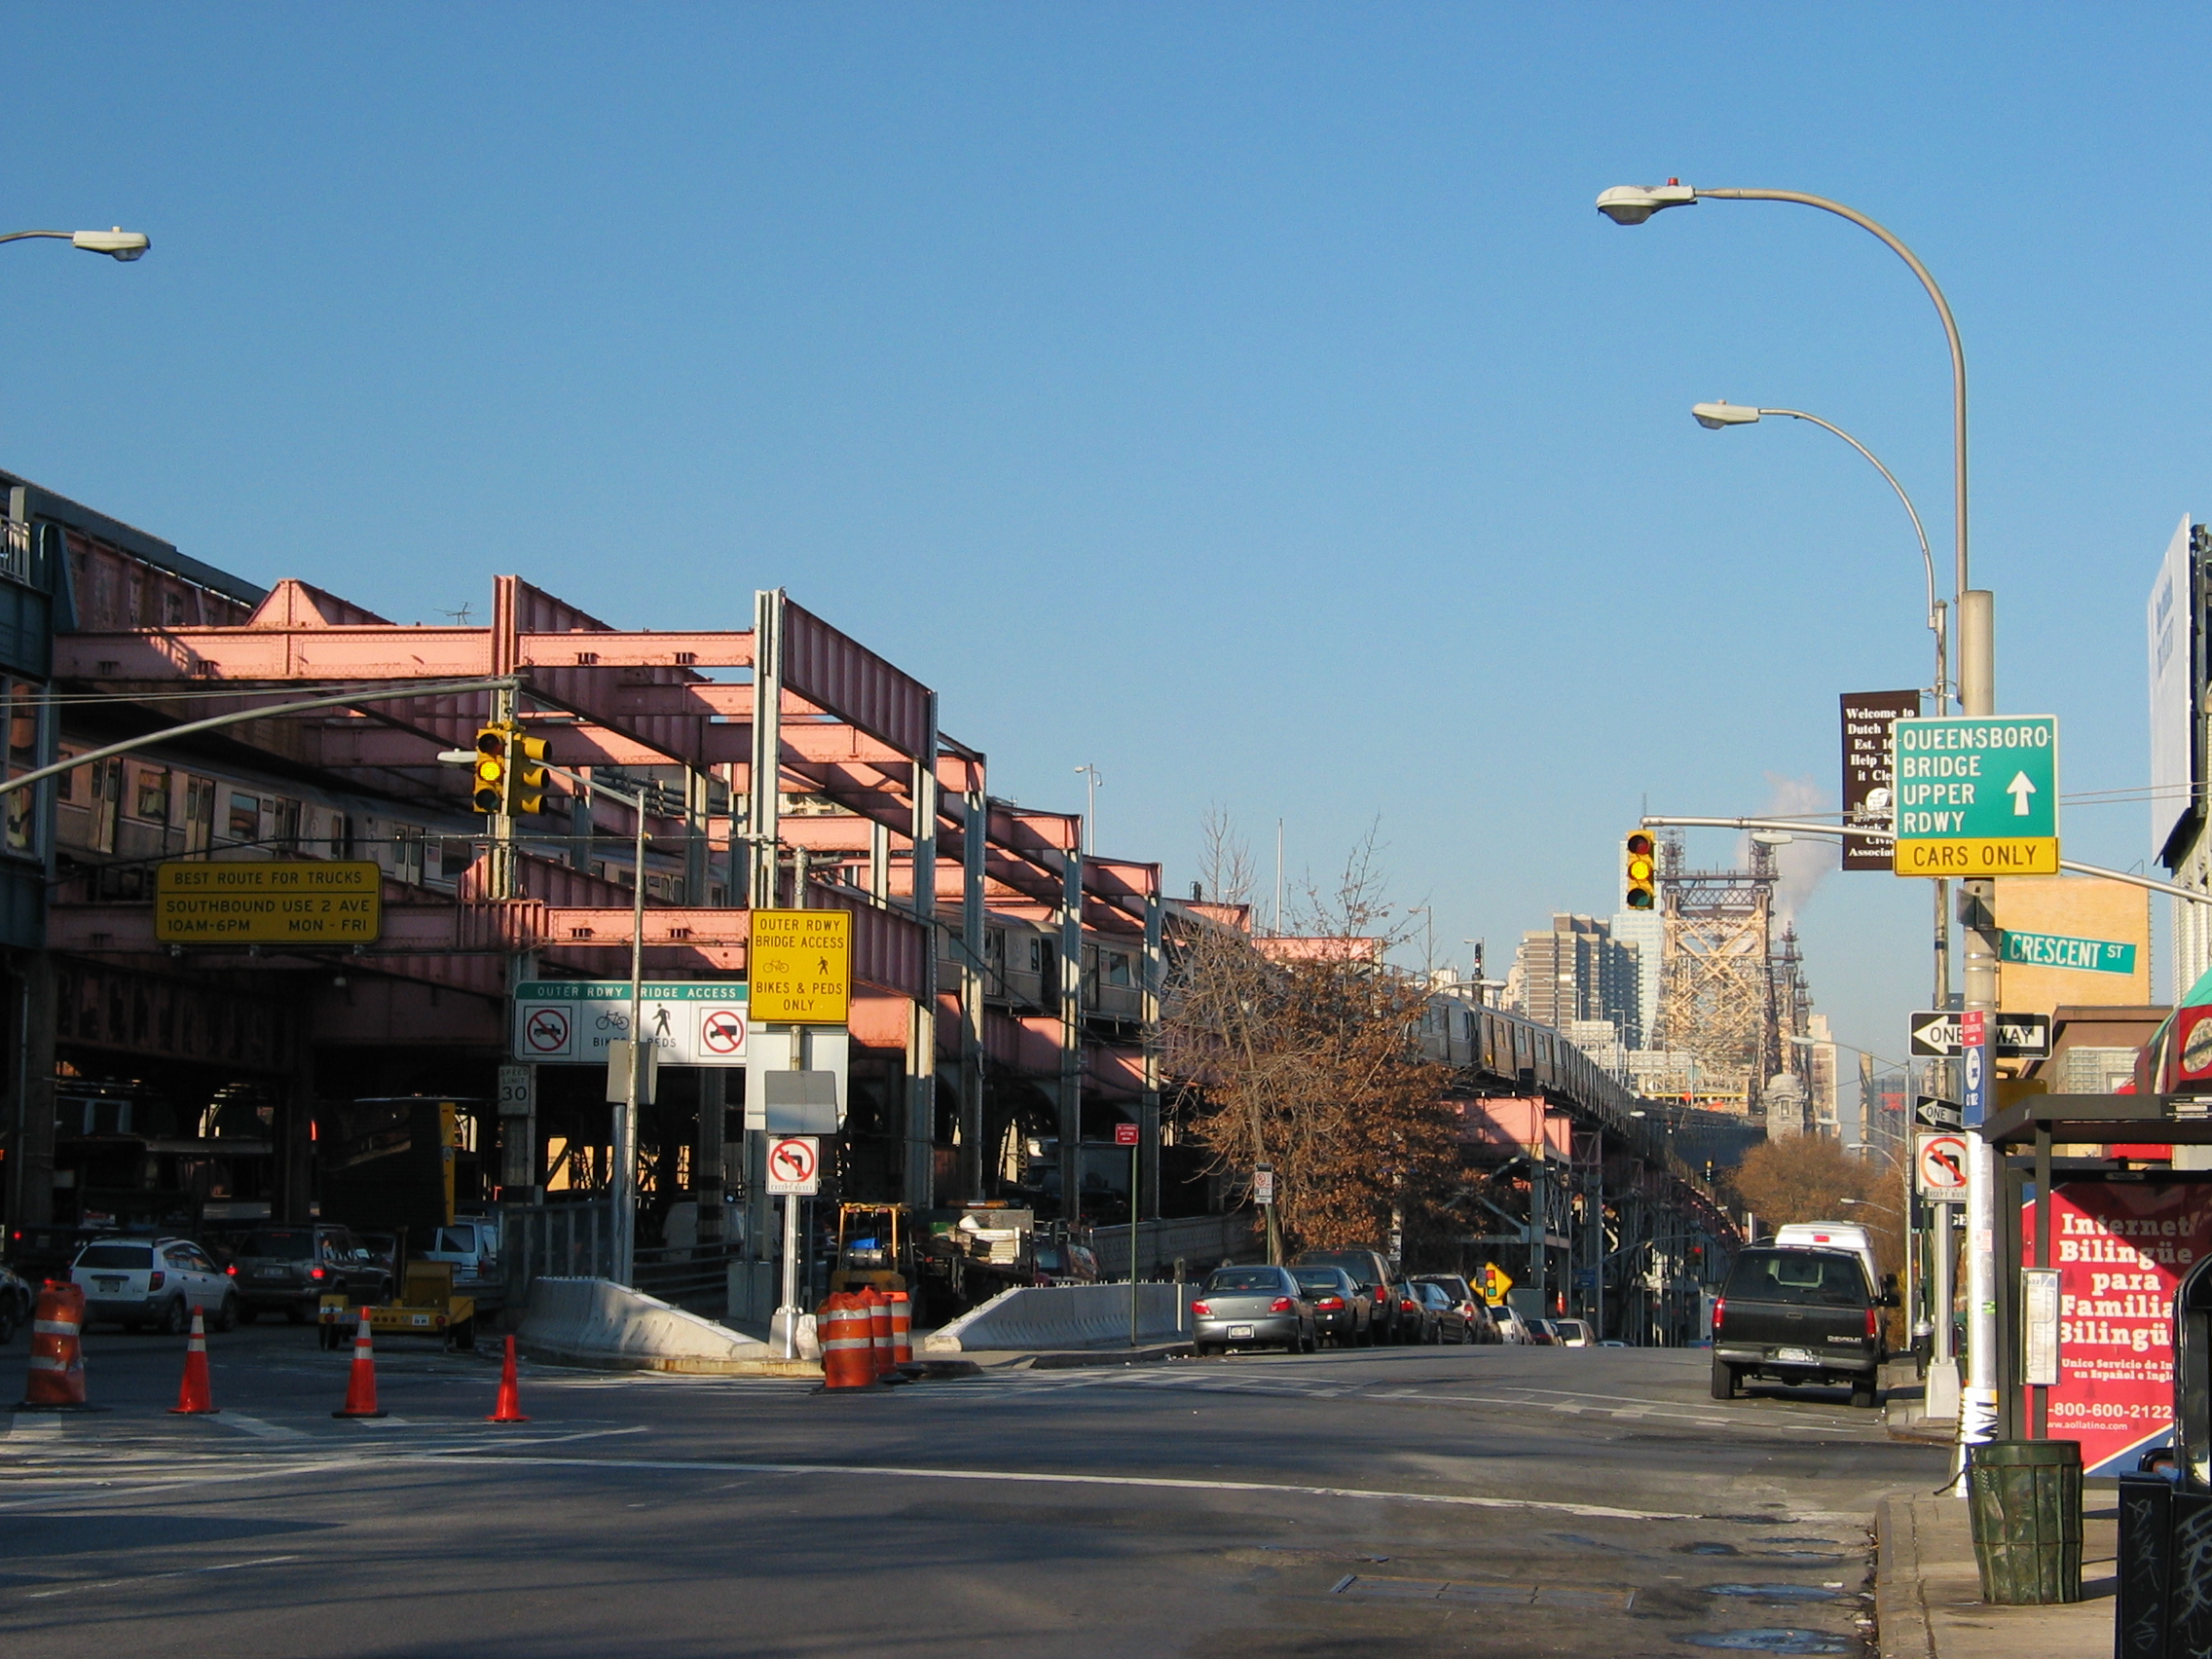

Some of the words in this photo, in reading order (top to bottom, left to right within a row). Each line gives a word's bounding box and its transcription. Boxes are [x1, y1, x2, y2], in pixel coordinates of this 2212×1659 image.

[1846, 708, 1897, 719] Welcome
[1902, 708, 1915, 719] to
[1847, 723, 1881, 735] Dutch
[1854, 738, 1876, 750] Est.
[1903, 725, 2048, 751] QUEENSBORO
[1850, 754, 1877, 768] Help
[1902, 756, 1981, 778] BRIDGE
[1858, 769, 1866, 782] it
[1872, 769, 1893, 782] Cle
[1902, 783, 1975, 806] UPPER
[1902, 811, 1966, 833] RDWY
[1849, 846, 1895, 857] Associat
[1913, 845, 1969, 866] CARS
[1981, 845, 2037, 866] ONLY
[174, 871, 209, 884] BEST
[217, 871, 263, 884] ROUTE
[272, 871, 299, 884] FOR
[308, 871, 362, 884] TRUCKS
[166, 900, 276, 912] SOUTHBOUND
[282, 900, 313, 912] USE
[321, 900, 331, 912] 2
[339, 900, 370, 912] AVE
[167, 919, 250, 932] 10AM-6PM
[289, 919, 323, 932] MON
[342, 919, 366, 932] FRI
[760, 918, 799, 931] OUTER
[806, 920, 840, 931] RDWY
[756, 936, 795, 948] BRIDGE
[800, 937, 844, 949] ACCESS
[2009, 934, 2102, 968] CRESCENT
[2107, 944, 2124, 959] ST
[537, 986, 578, 997] OUTER
[587, 987, 624, 997] RDWY
[640, 987, 679, 998] RIDGE
[687, 988, 737, 999] ACCESS
[756, 981, 791, 994] BIKES
[796, 982, 805, 994] &
[812, 982, 843, 995] PEDS
[783, 999, 815, 1011] ONLY
[1930, 1027, 1963, 1044] ONE
[1996, 1028, 2032, 1044] WAY
[501, 1086, 527, 1101] 30
[1926, 1107, 1946, 1121] ONE
[2061, 1213, 2191, 1236] Internet
[2058, 1239, 2193, 1271] Bilingüe
[2090, 1272, 2161, 1297] para
[2061, 1294, 2173, 1318] Familia
[2060, 1320, 2170, 1352] Bilingü
[2061, 1358, 2094, 1369] Unico
[2096, 1358, 2142, 1370] Servicio
[2144, 1359, 2157, 1370] de
[2090, 1369, 2135, 1382] Español
